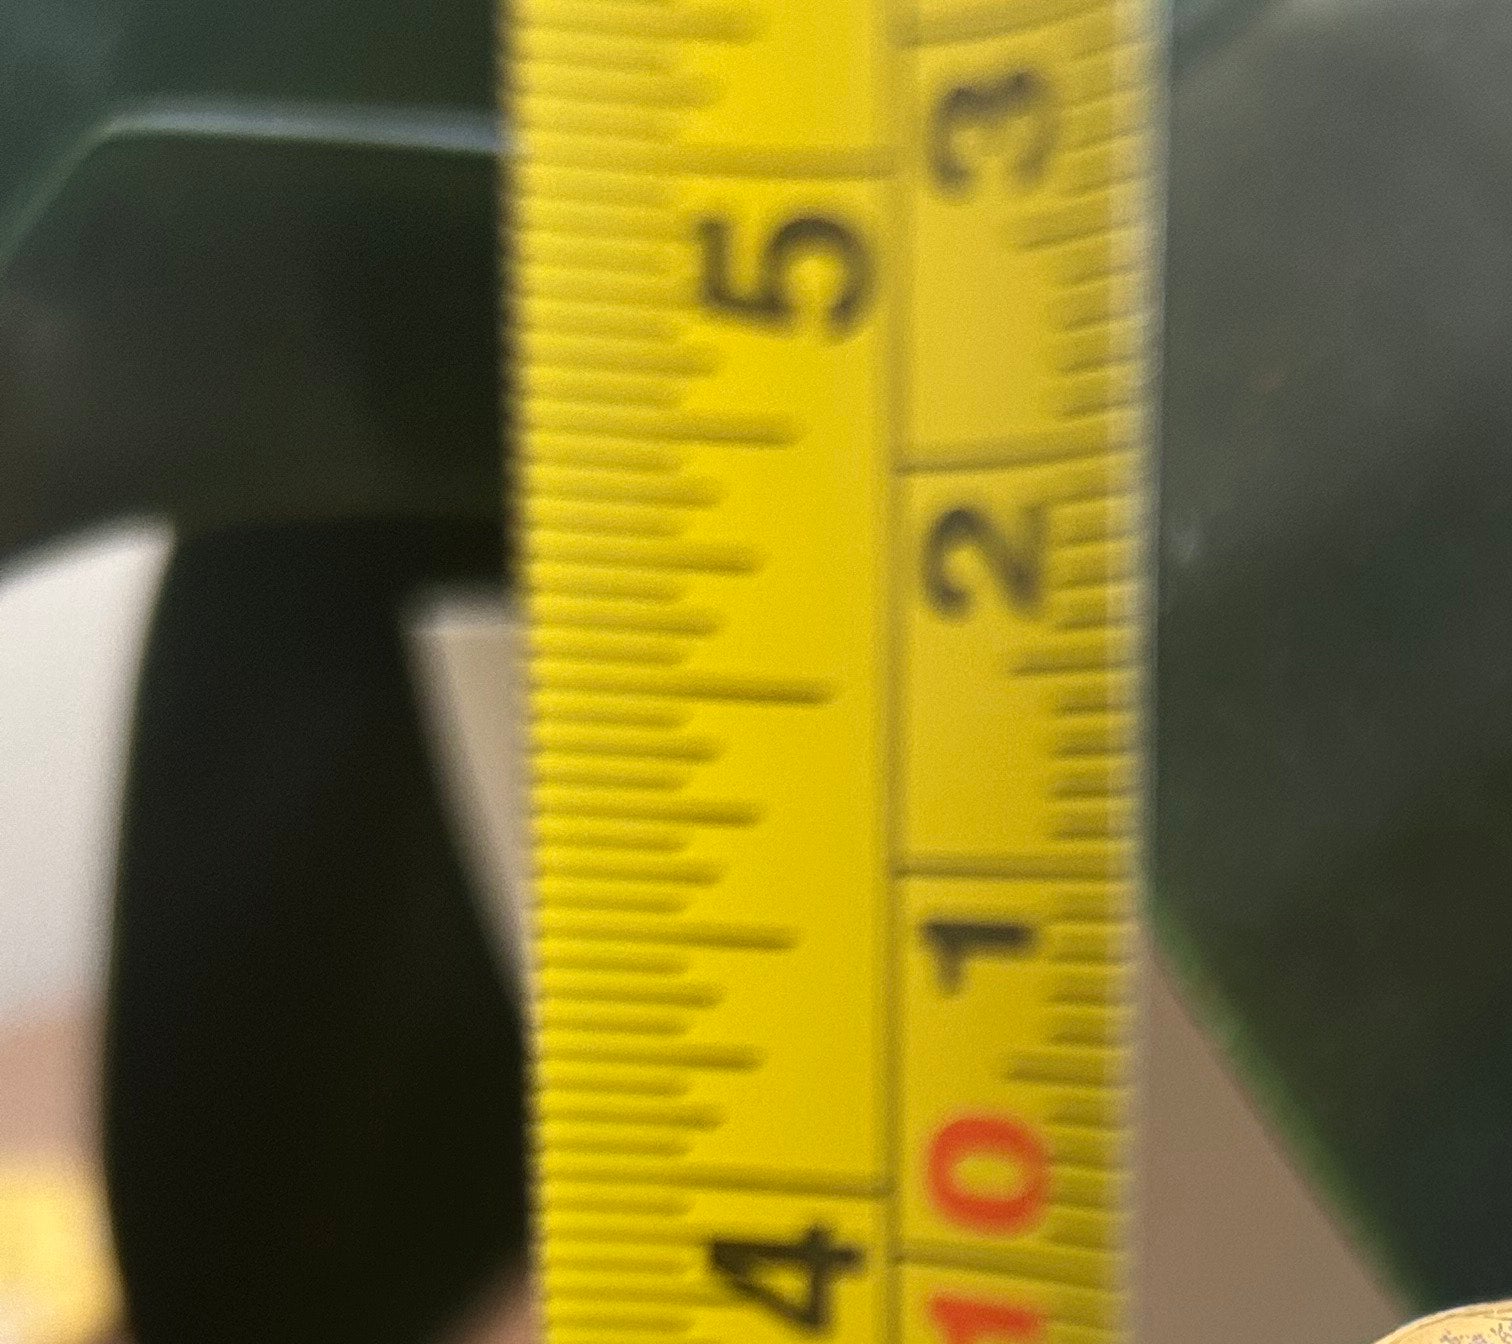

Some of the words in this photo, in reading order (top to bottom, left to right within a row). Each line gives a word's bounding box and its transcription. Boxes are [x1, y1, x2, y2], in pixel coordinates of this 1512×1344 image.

[923, 68, 1059, 194] 3
[690, 208, 877, 346] 5
[919, 502, 1047, 622] 2
[921, 917, 1037, 997] 1
[706, 1222, 866, 1338] 4
